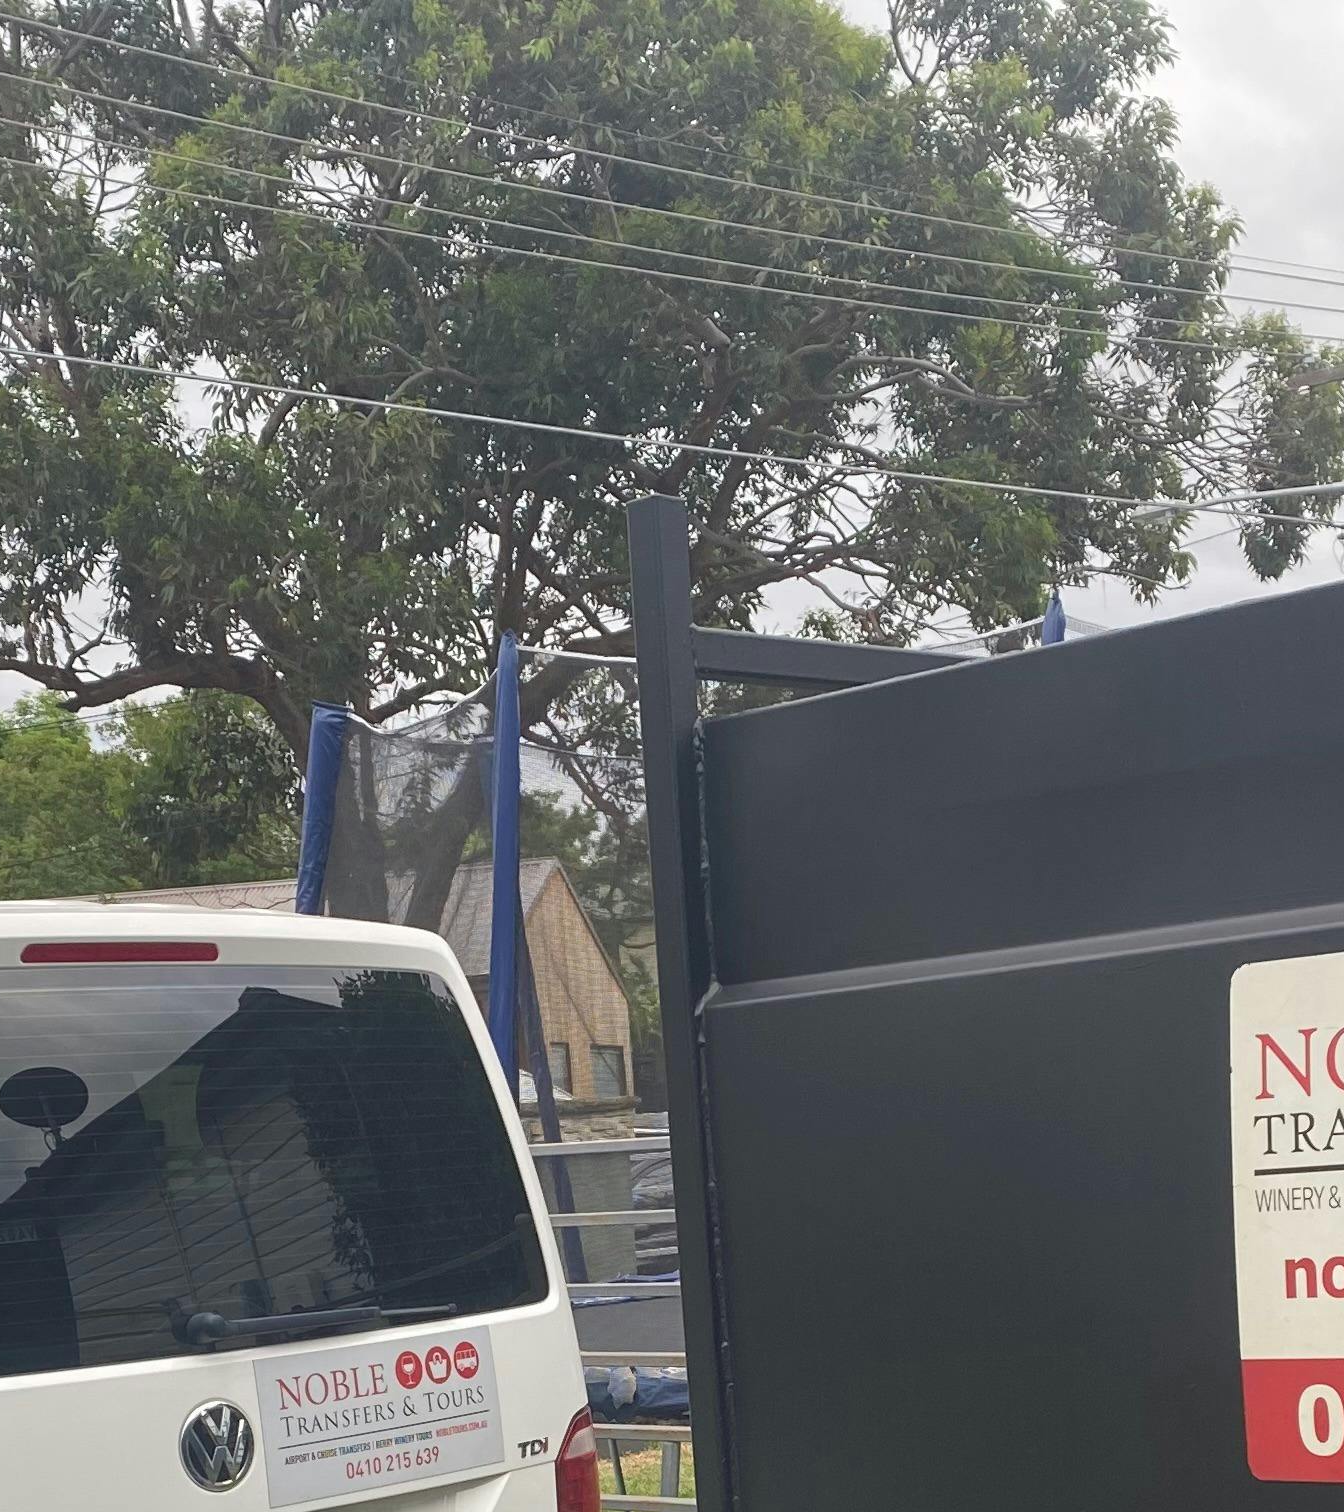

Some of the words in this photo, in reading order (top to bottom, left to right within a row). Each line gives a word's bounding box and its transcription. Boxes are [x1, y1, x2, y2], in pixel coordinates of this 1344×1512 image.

[1255, 1183, 1325, 1213] WINERY
[1328, 1181, 1343, 1209] &
[275, 1363, 388, 1411] NOBLE
[279, 1402, 395, 1438] TRANSFERS
[403, 1396, 418, 1417] &
[424, 1386, 485, 1412] TOURS
[346, 1457, 381, 1479] 0410
[386, 1452, 411, 1472] 215
[416, 1446, 439, 1465] 639
[517, 1436, 549, 1459] TDI
